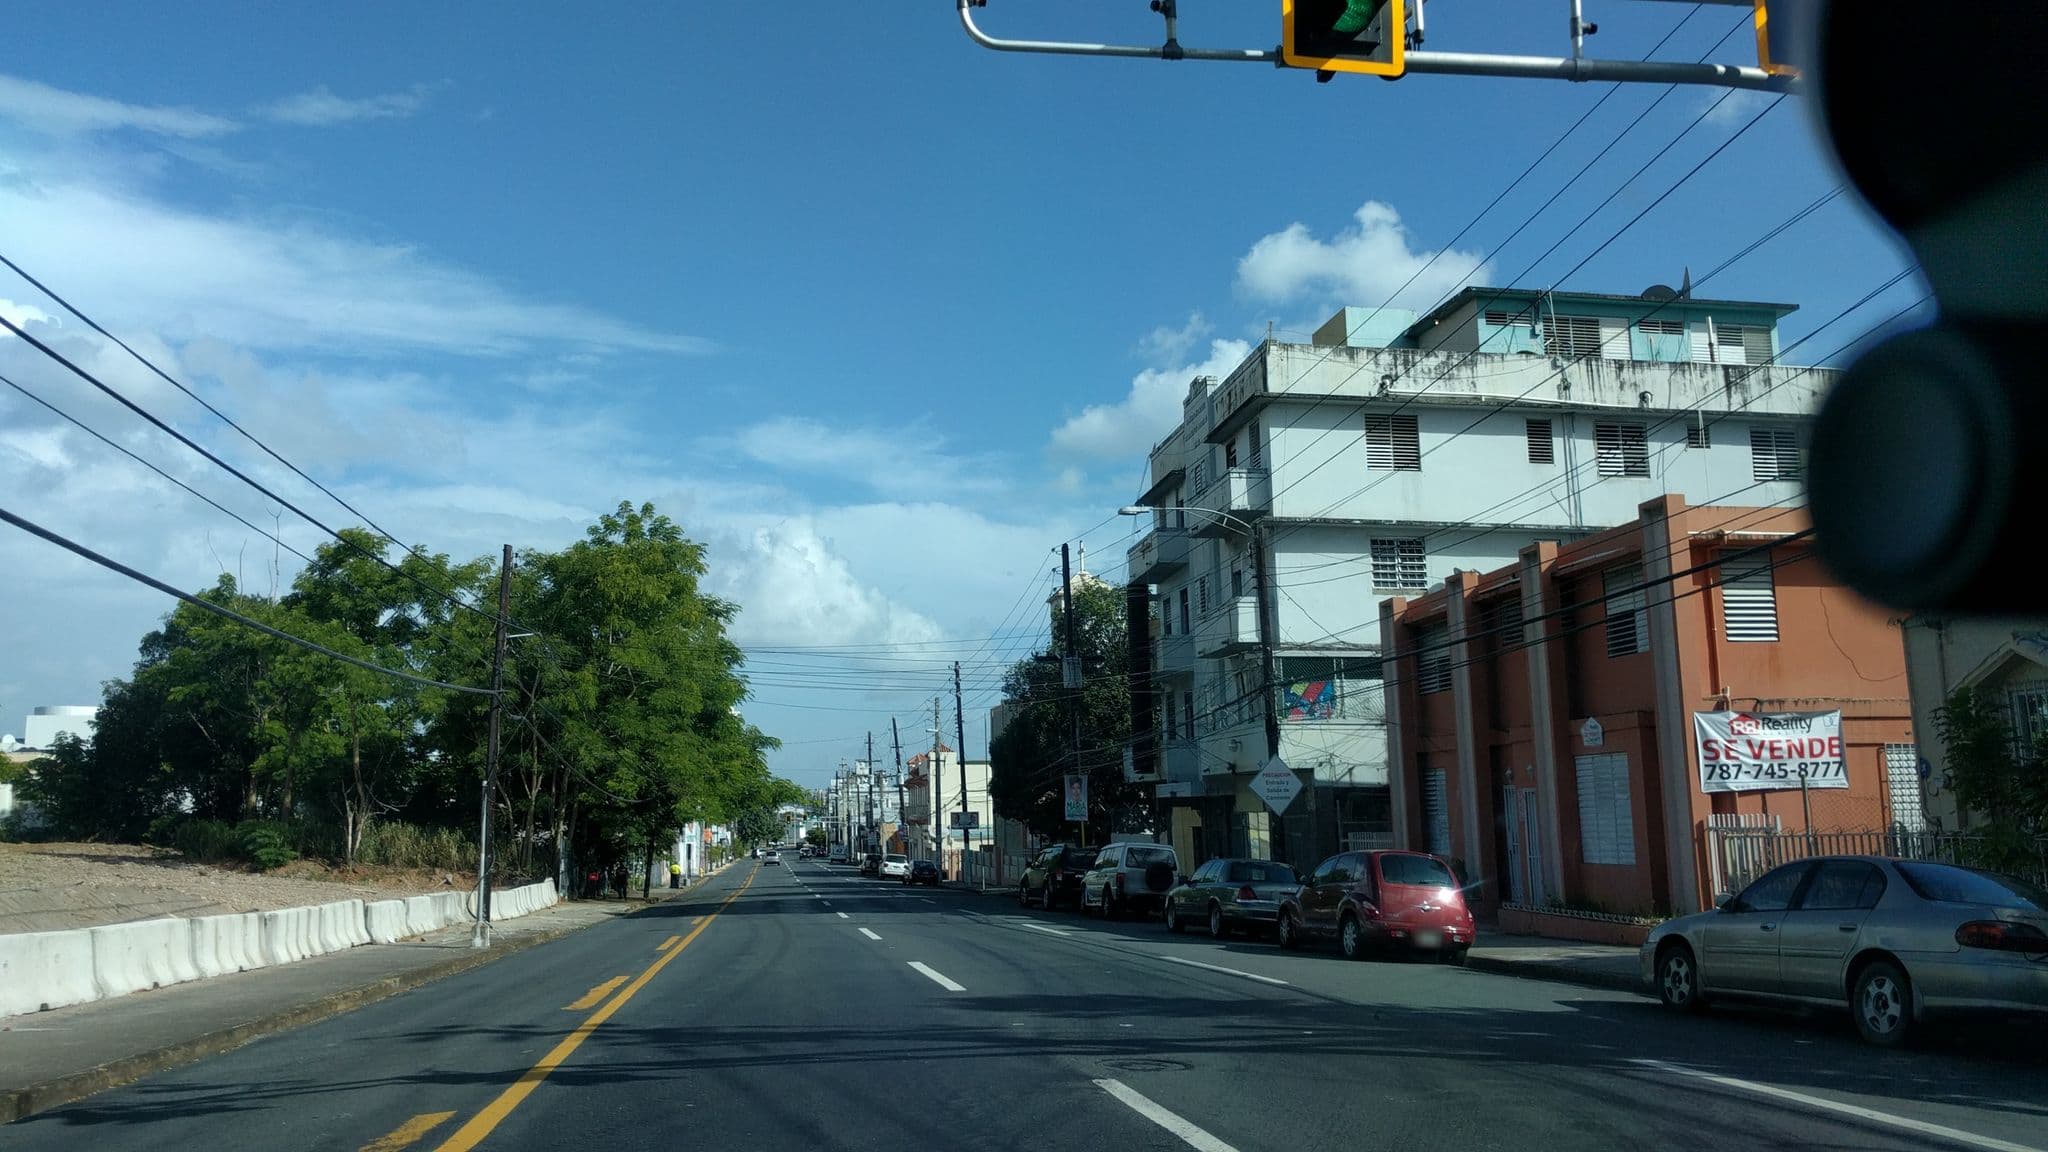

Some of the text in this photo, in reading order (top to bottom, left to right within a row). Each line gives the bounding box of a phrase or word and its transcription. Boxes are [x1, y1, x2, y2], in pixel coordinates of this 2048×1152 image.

[1702, 736, 1841, 761] SE VENDE
[1704, 762, 1843, 780] 787-745-8777
